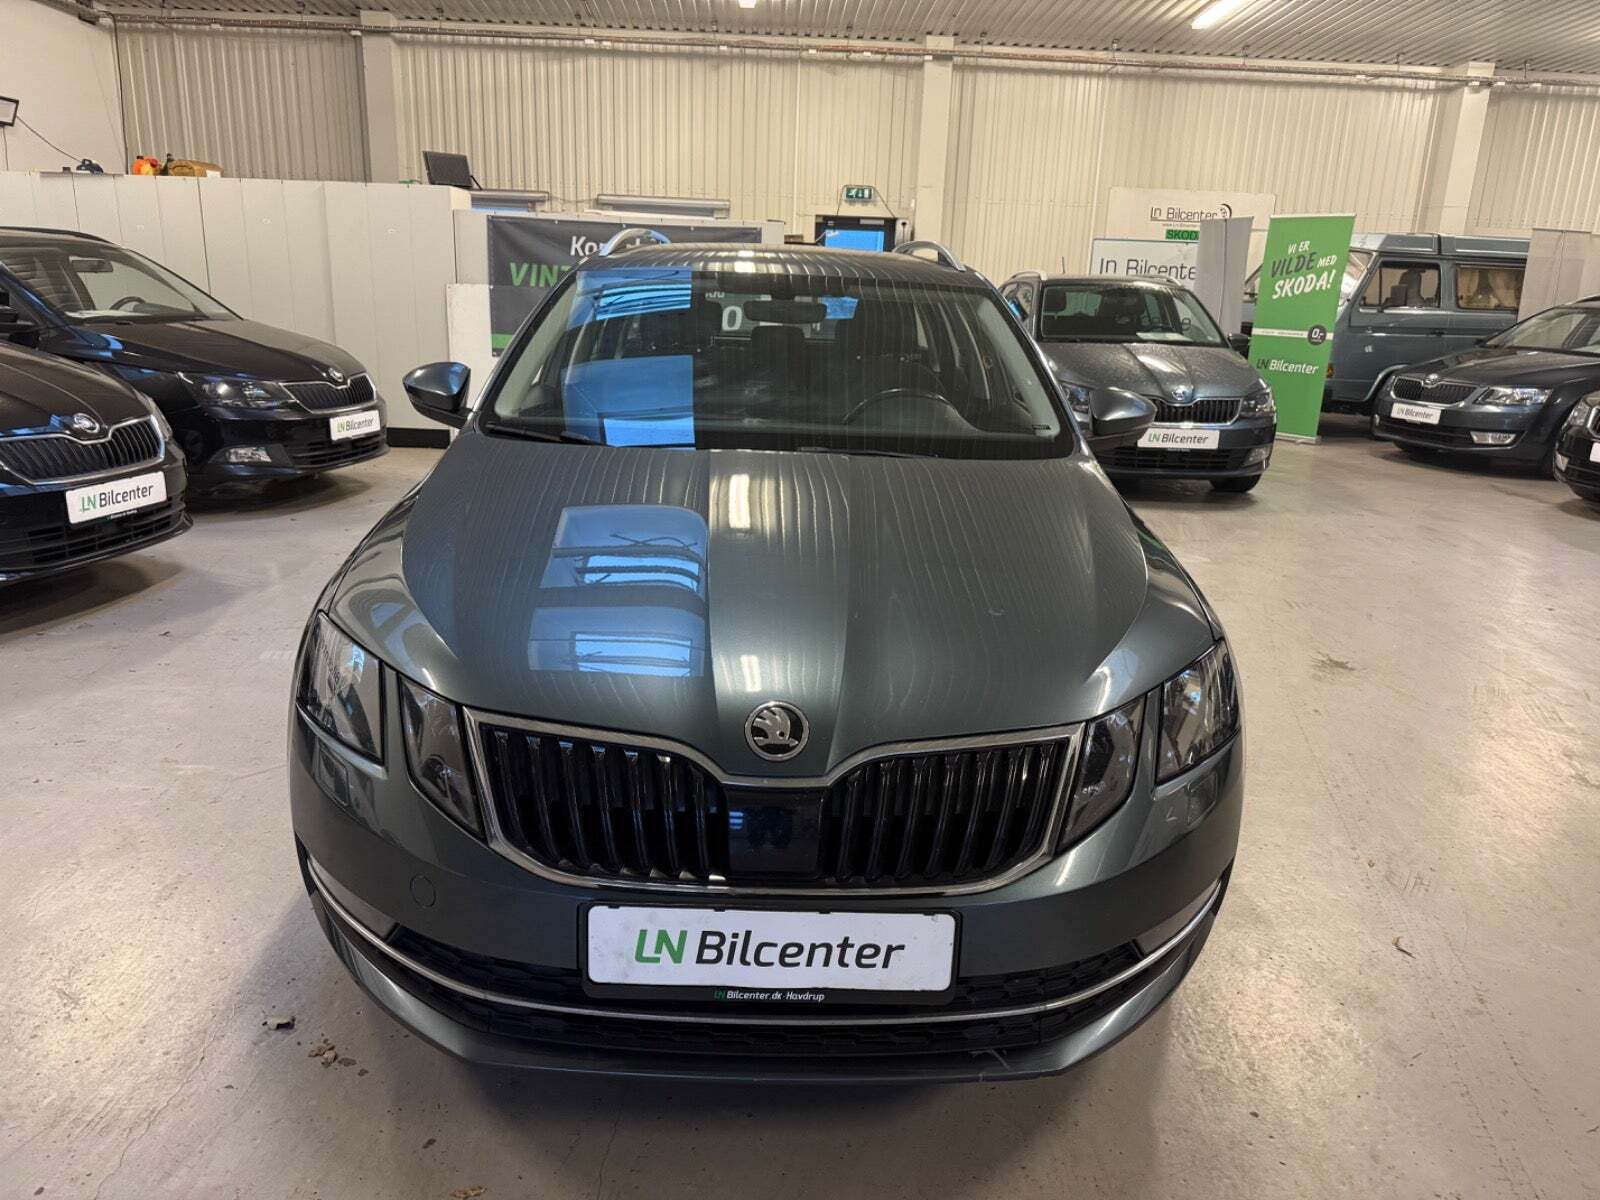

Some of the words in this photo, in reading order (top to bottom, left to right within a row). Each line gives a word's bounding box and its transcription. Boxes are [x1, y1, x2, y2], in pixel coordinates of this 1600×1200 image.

[1165, 229, 1199, 241] SKOD
[1287, 243, 1297, 255] VI
[1298, 240, 1310, 252] ER
[1126, 258, 1197, 280] Bilcente
[1271, 251, 1317, 278] VILDE
[1317, 255, 1337, 268] MED
[1272, 269, 1336, 299] SKODA!
[1269, 360, 1319, 375] Bilcenter
[1161, 433, 1209, 444] Bilcenter
[99, 484, 154, 508] Bilcenter
[634, 928, 688, 964] LN
[695, 930, 906, 969] Bilcenter
